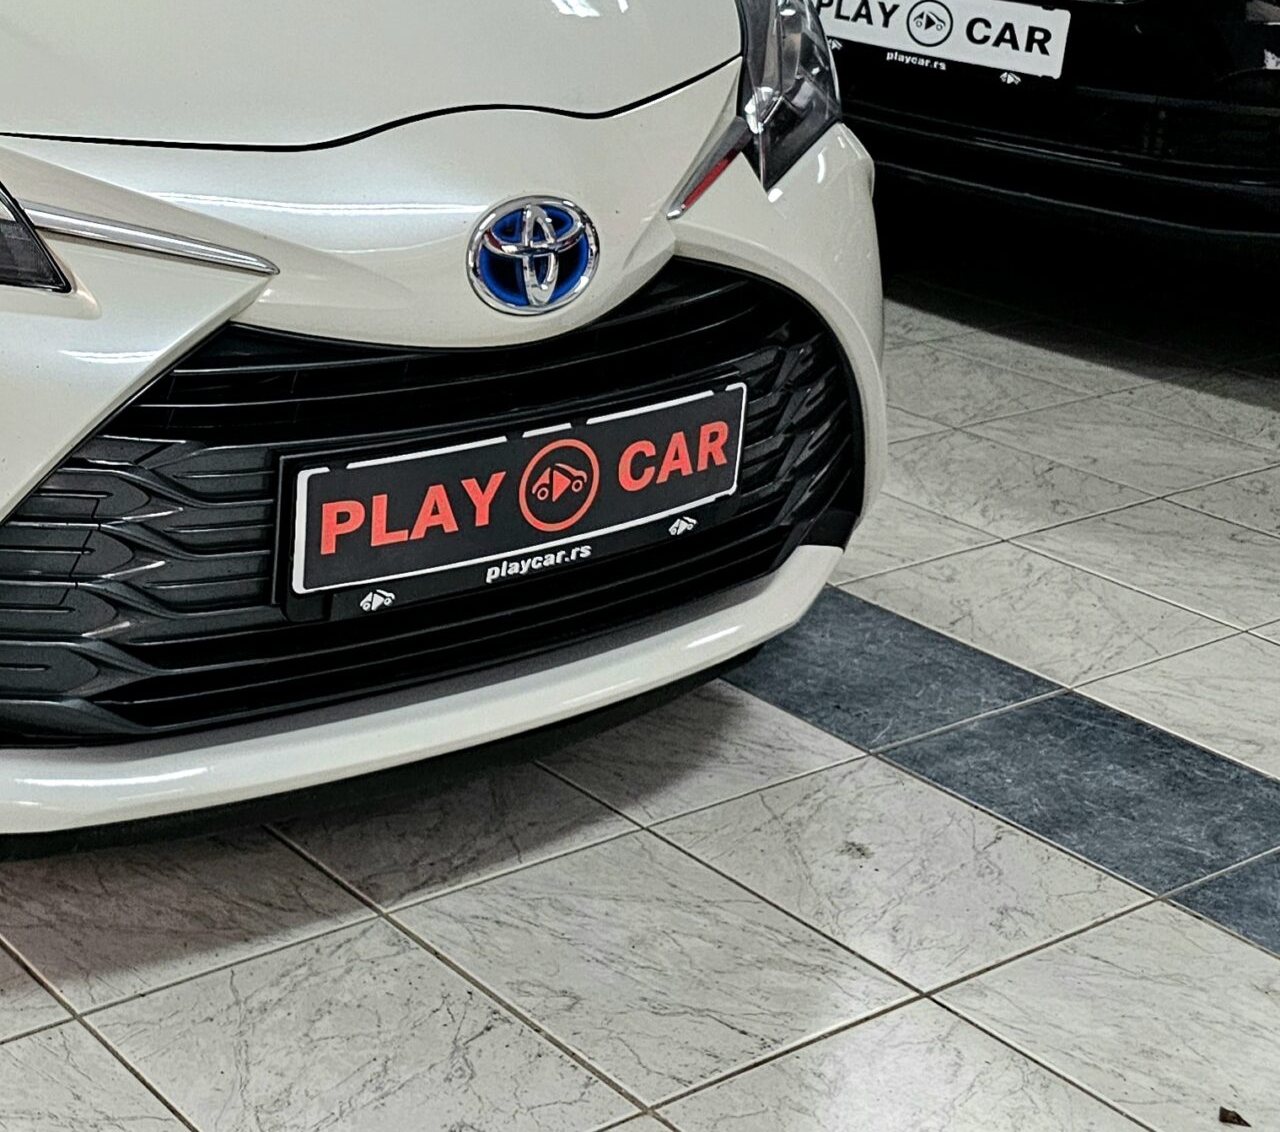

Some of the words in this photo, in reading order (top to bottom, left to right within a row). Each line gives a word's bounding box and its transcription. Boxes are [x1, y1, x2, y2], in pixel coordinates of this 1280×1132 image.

[965, 17, 1053, 57] CAR
[886, 51, 947, 70] playcar.rs
[320, 471, 507, 556] PLAY
[618, 420, 730, 493] CAR
[485, 543, 593, 584] playcar.rs
